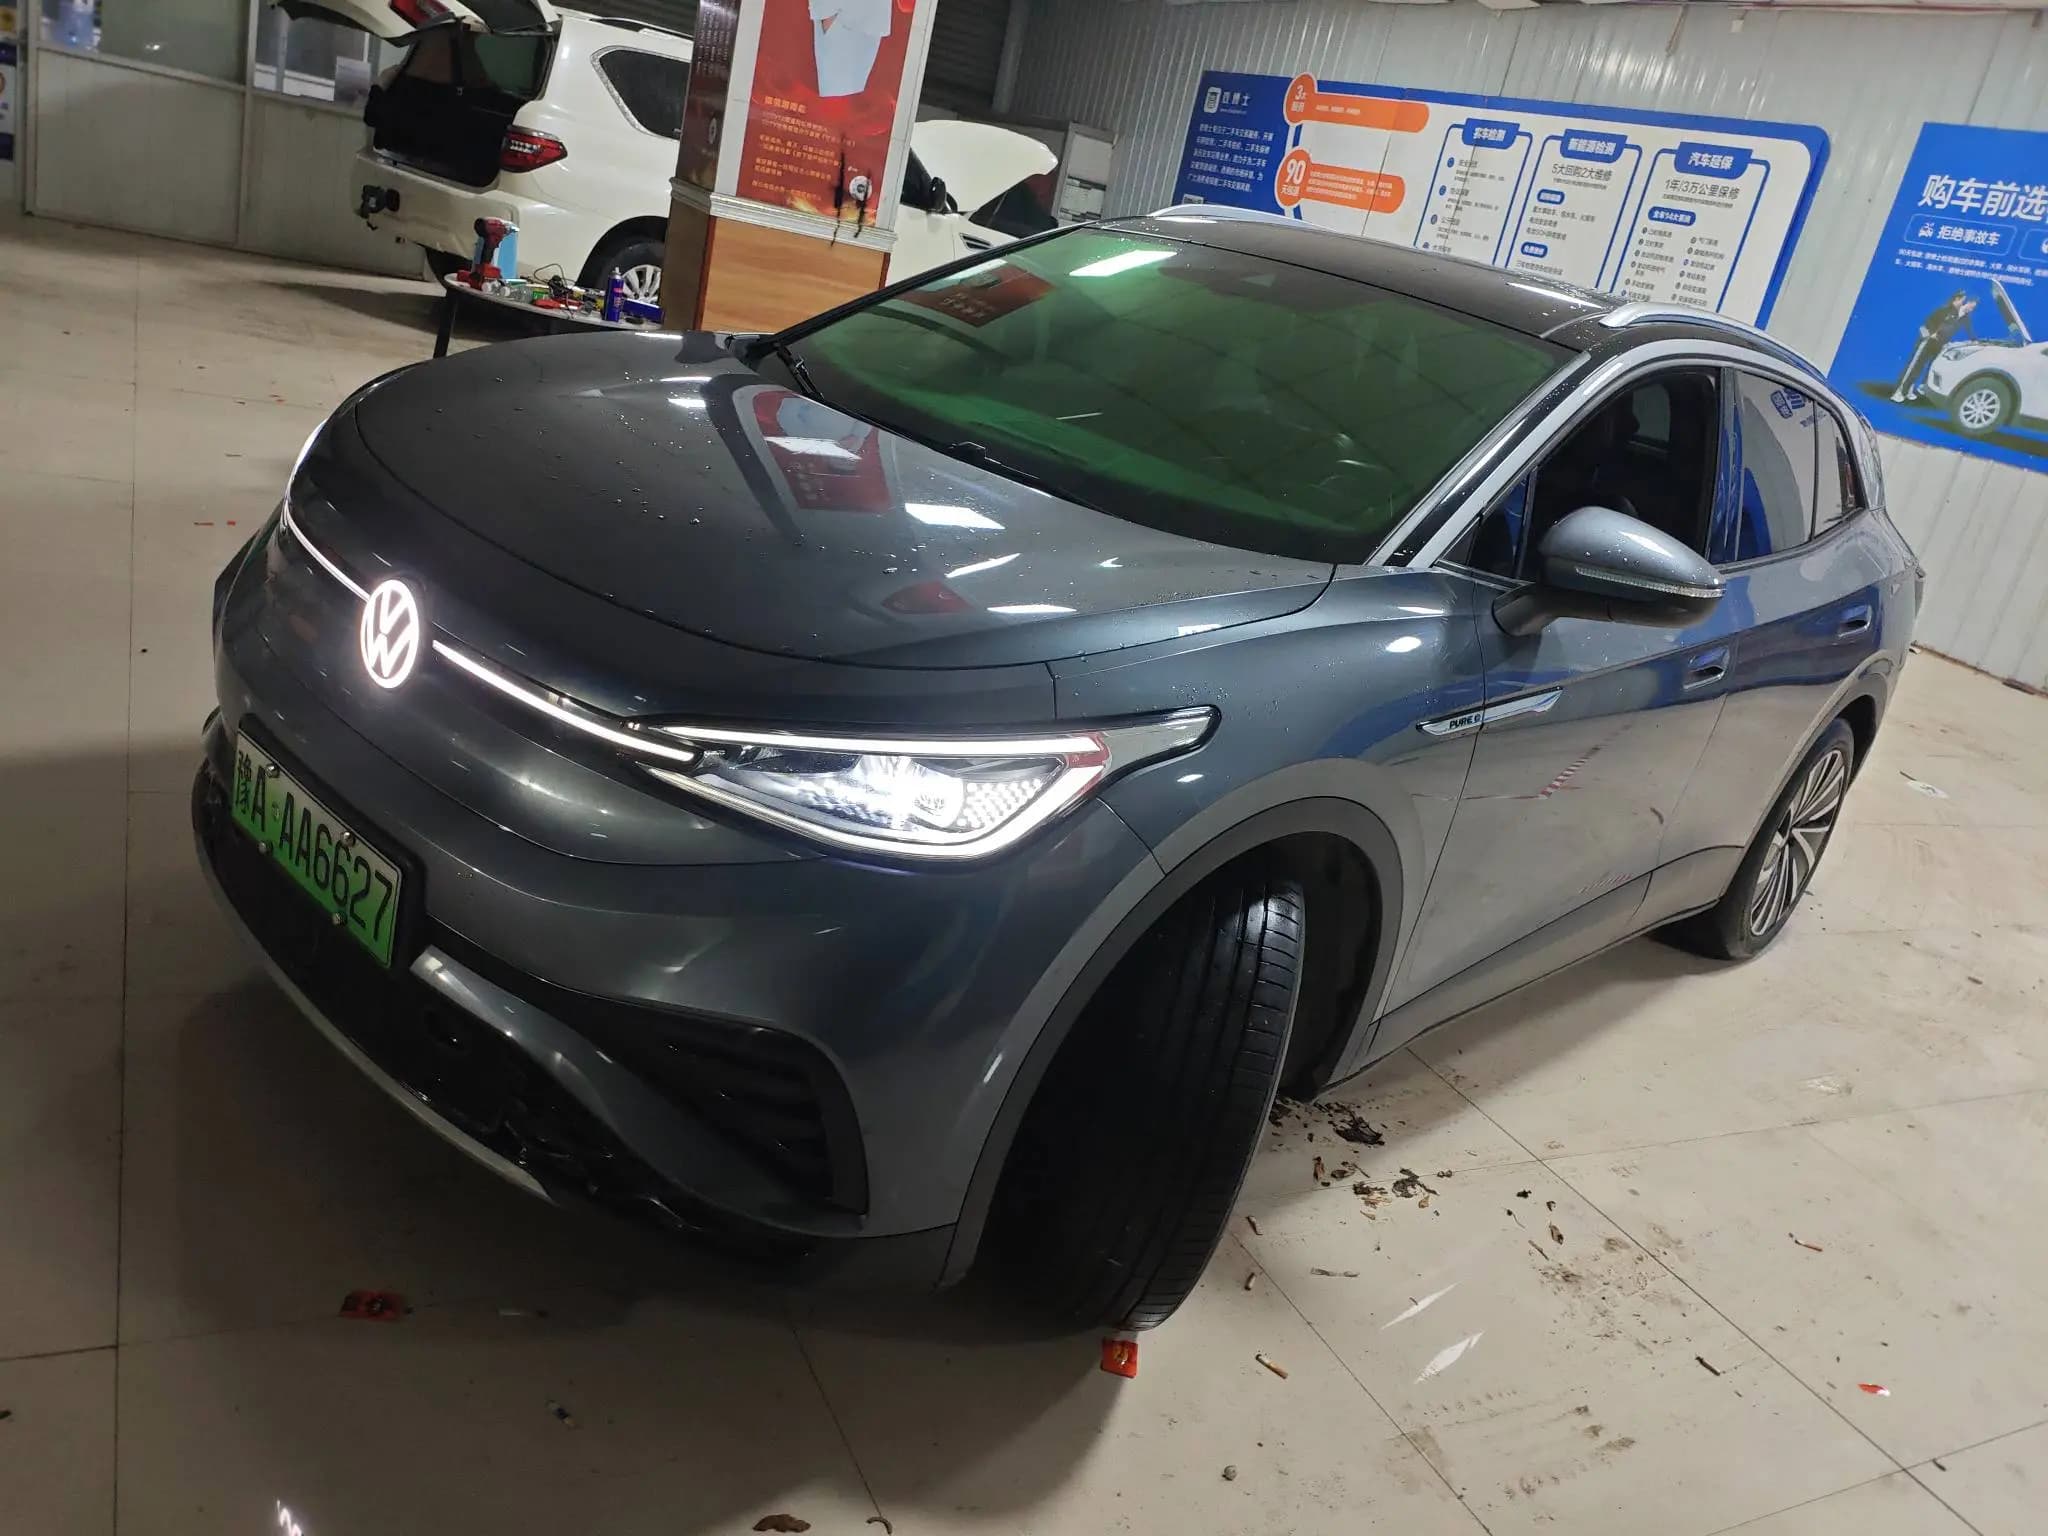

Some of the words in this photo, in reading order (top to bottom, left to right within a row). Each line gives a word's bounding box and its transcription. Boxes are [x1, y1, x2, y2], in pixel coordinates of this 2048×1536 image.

[1286, 158, 1306, 184] 90
[1688, 152, 1734, 171] 汽车延保
[1917, 174, 2048, 224] 购车前选
[1937, 225, 2001, 247] 拒绝事故车
[1449, 715, 1473, 729] PURE
